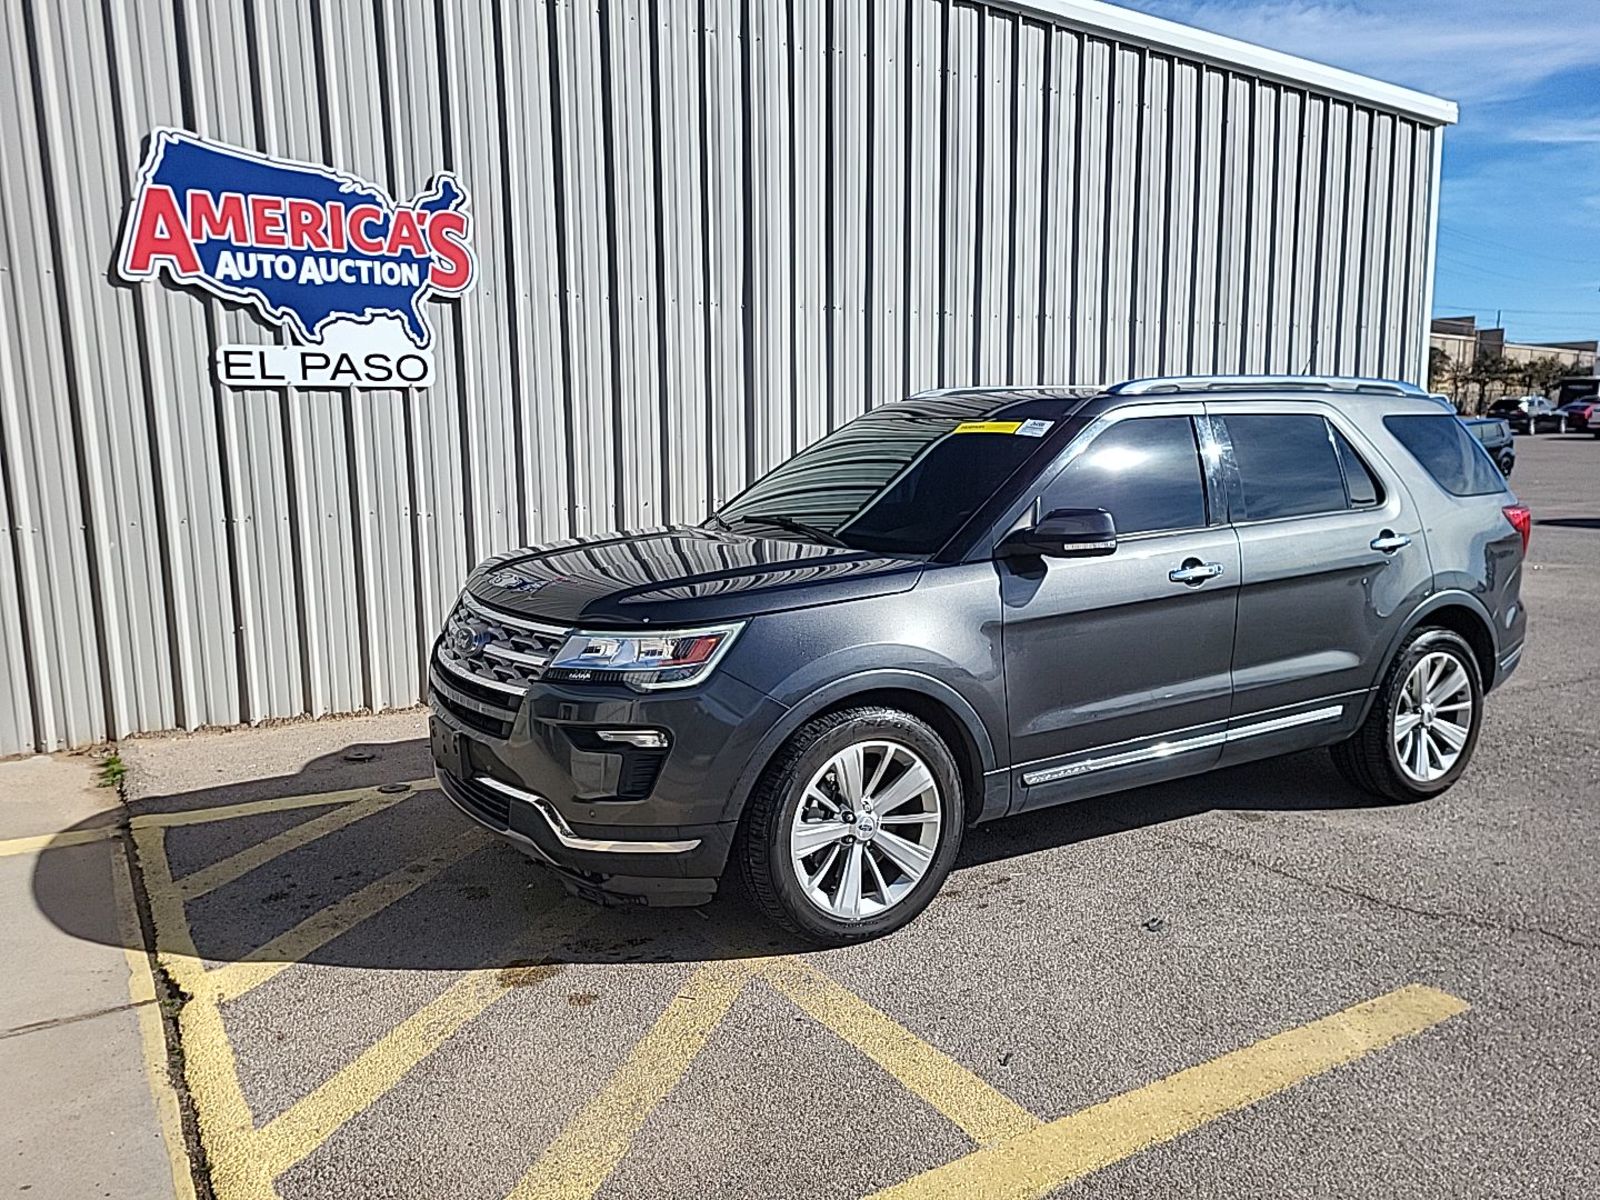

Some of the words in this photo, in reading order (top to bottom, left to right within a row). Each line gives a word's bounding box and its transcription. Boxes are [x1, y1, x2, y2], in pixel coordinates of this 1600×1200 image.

[129, 187, 472, 289] AMERICA'S
[215, 250, 298, 281] AUTO
[299, 255, 420, 287] AUCTION
[223, 350, 285, 380] EL
[301, 353, 428, 382] PASO
